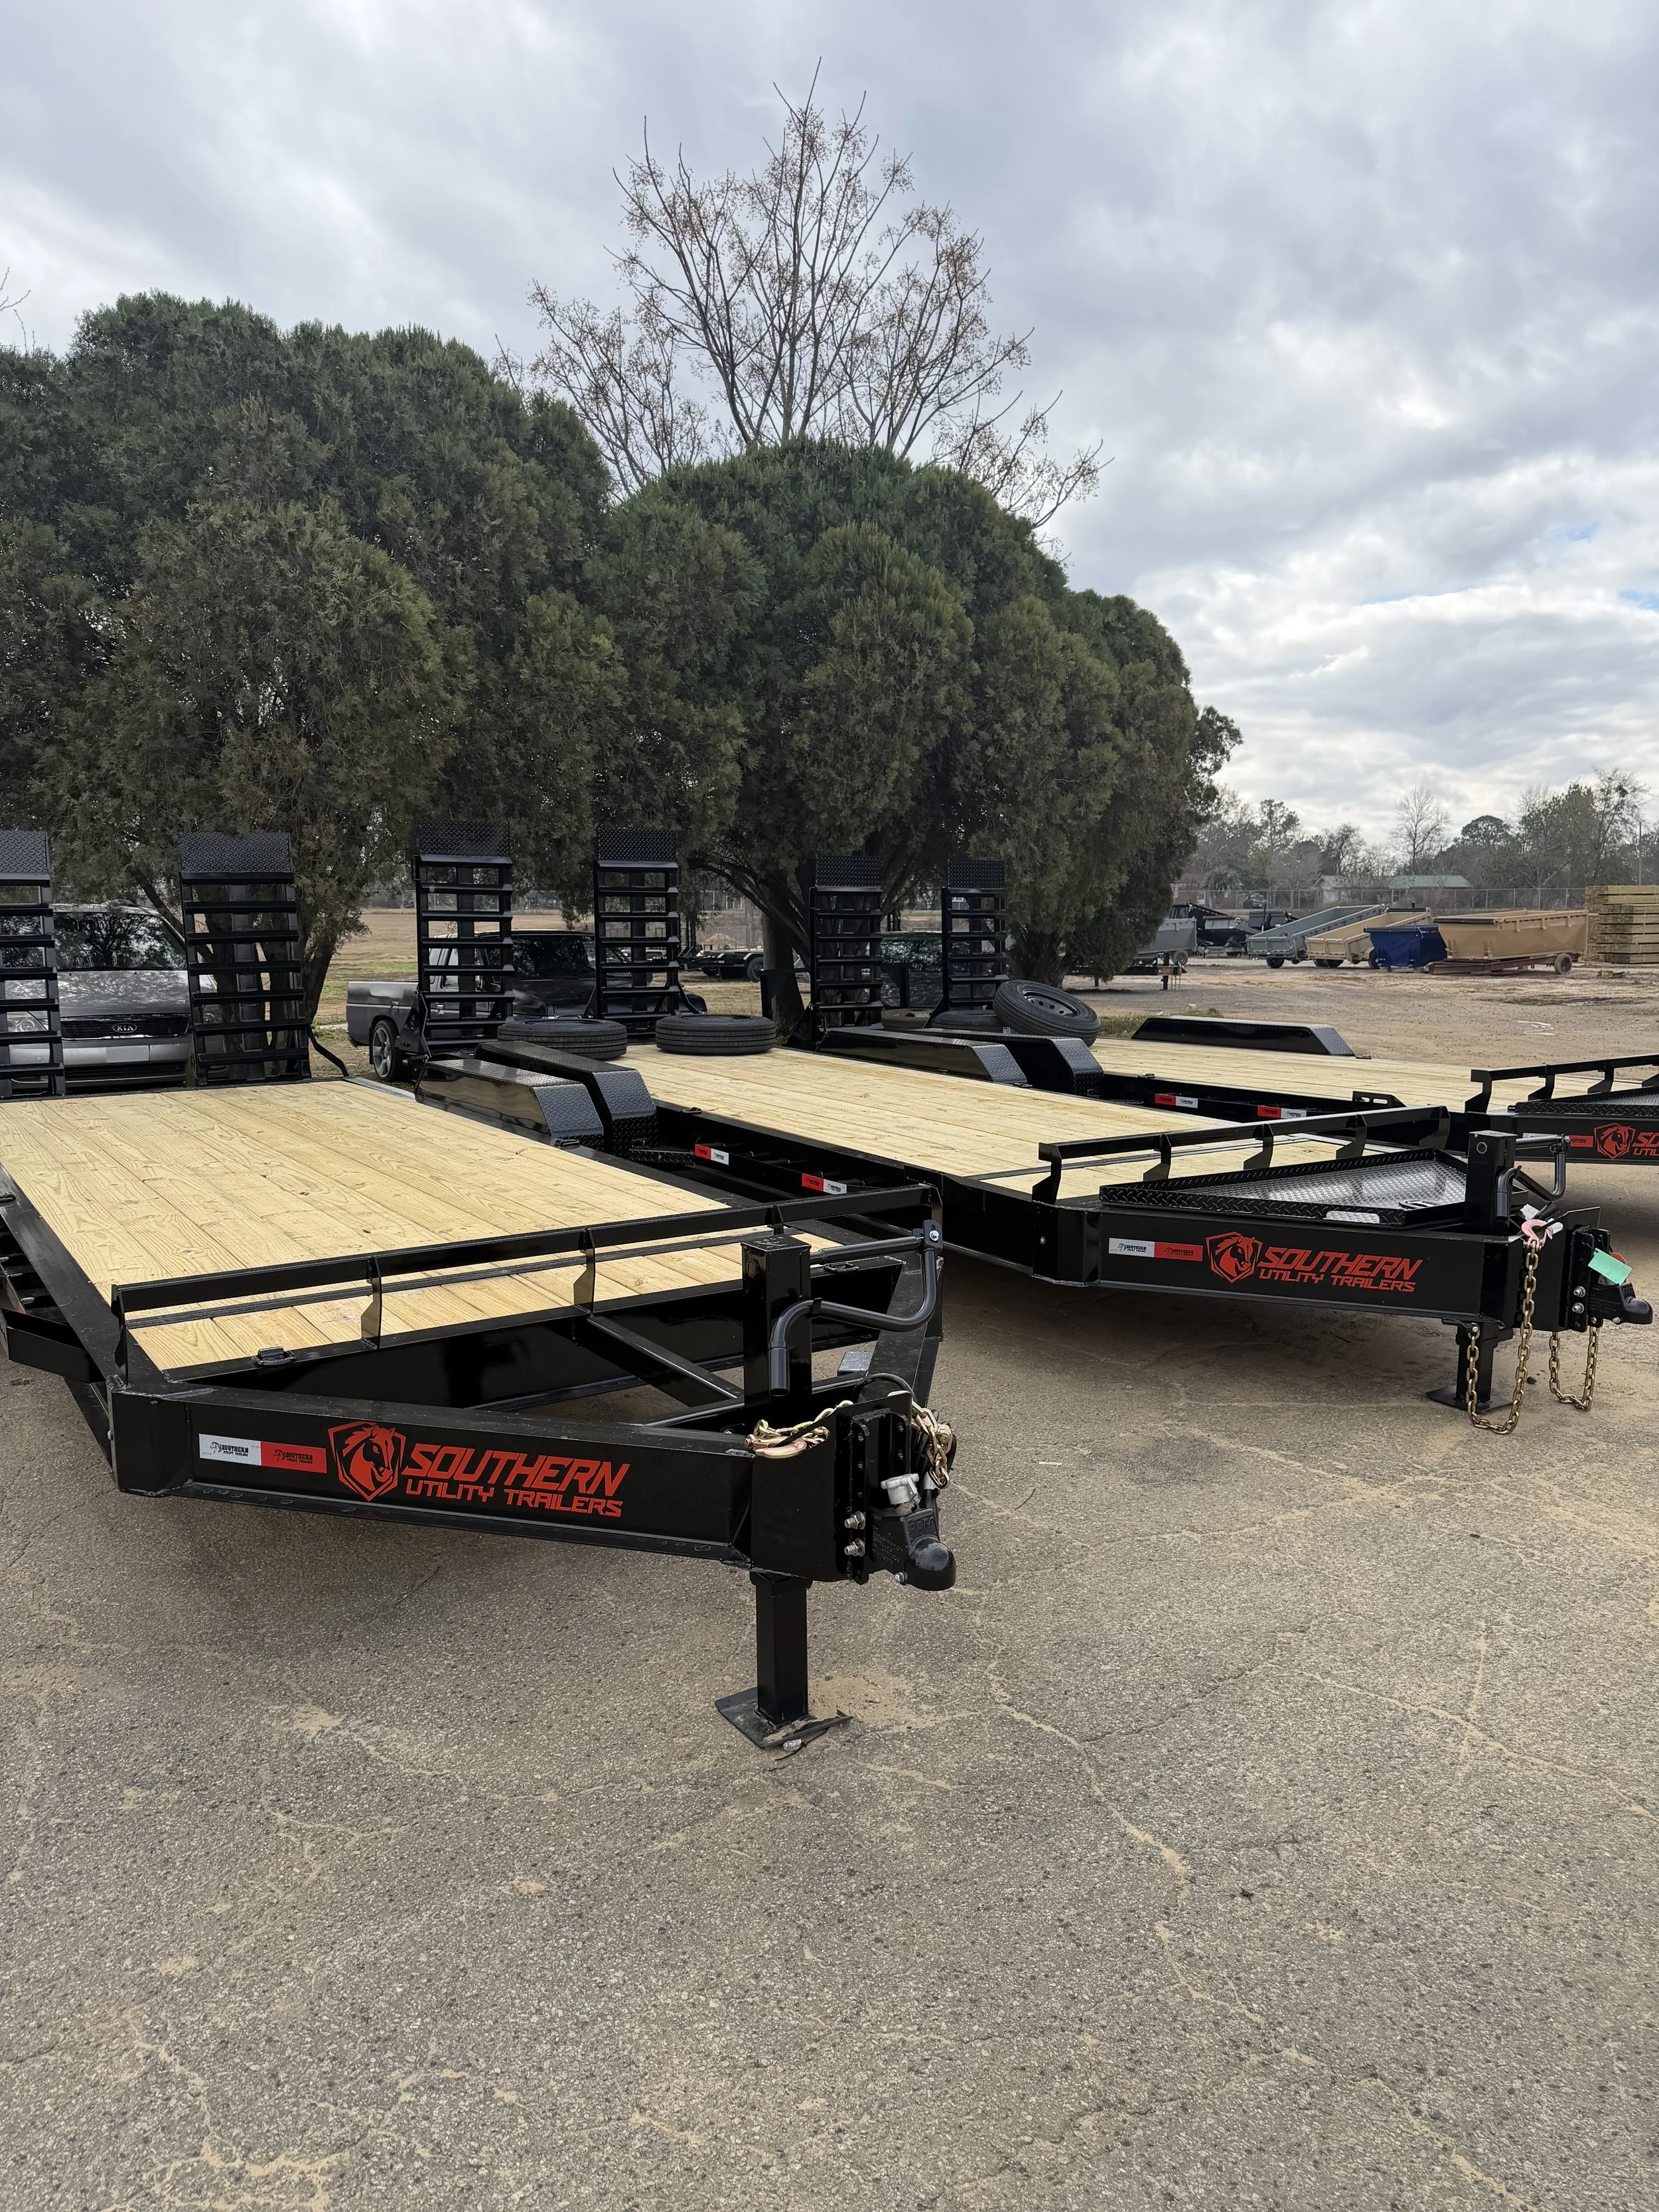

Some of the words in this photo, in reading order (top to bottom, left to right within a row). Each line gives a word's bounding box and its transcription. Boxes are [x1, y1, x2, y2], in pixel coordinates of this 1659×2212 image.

[1257, 1246, 1423, 1280] SOUTHERN
[1259, 1268, 1324, 1284] UTILITY
[1331, 1275, 1416, 1293] TRAILERS
[222, 1444, 249, 1453] SOUTHERN
[401, 1443, 630, 1497] SOUTHERN
[405, 1479, 495, 1503] UTILITY
[504, 1489, 624, 1517] TRAILERS
